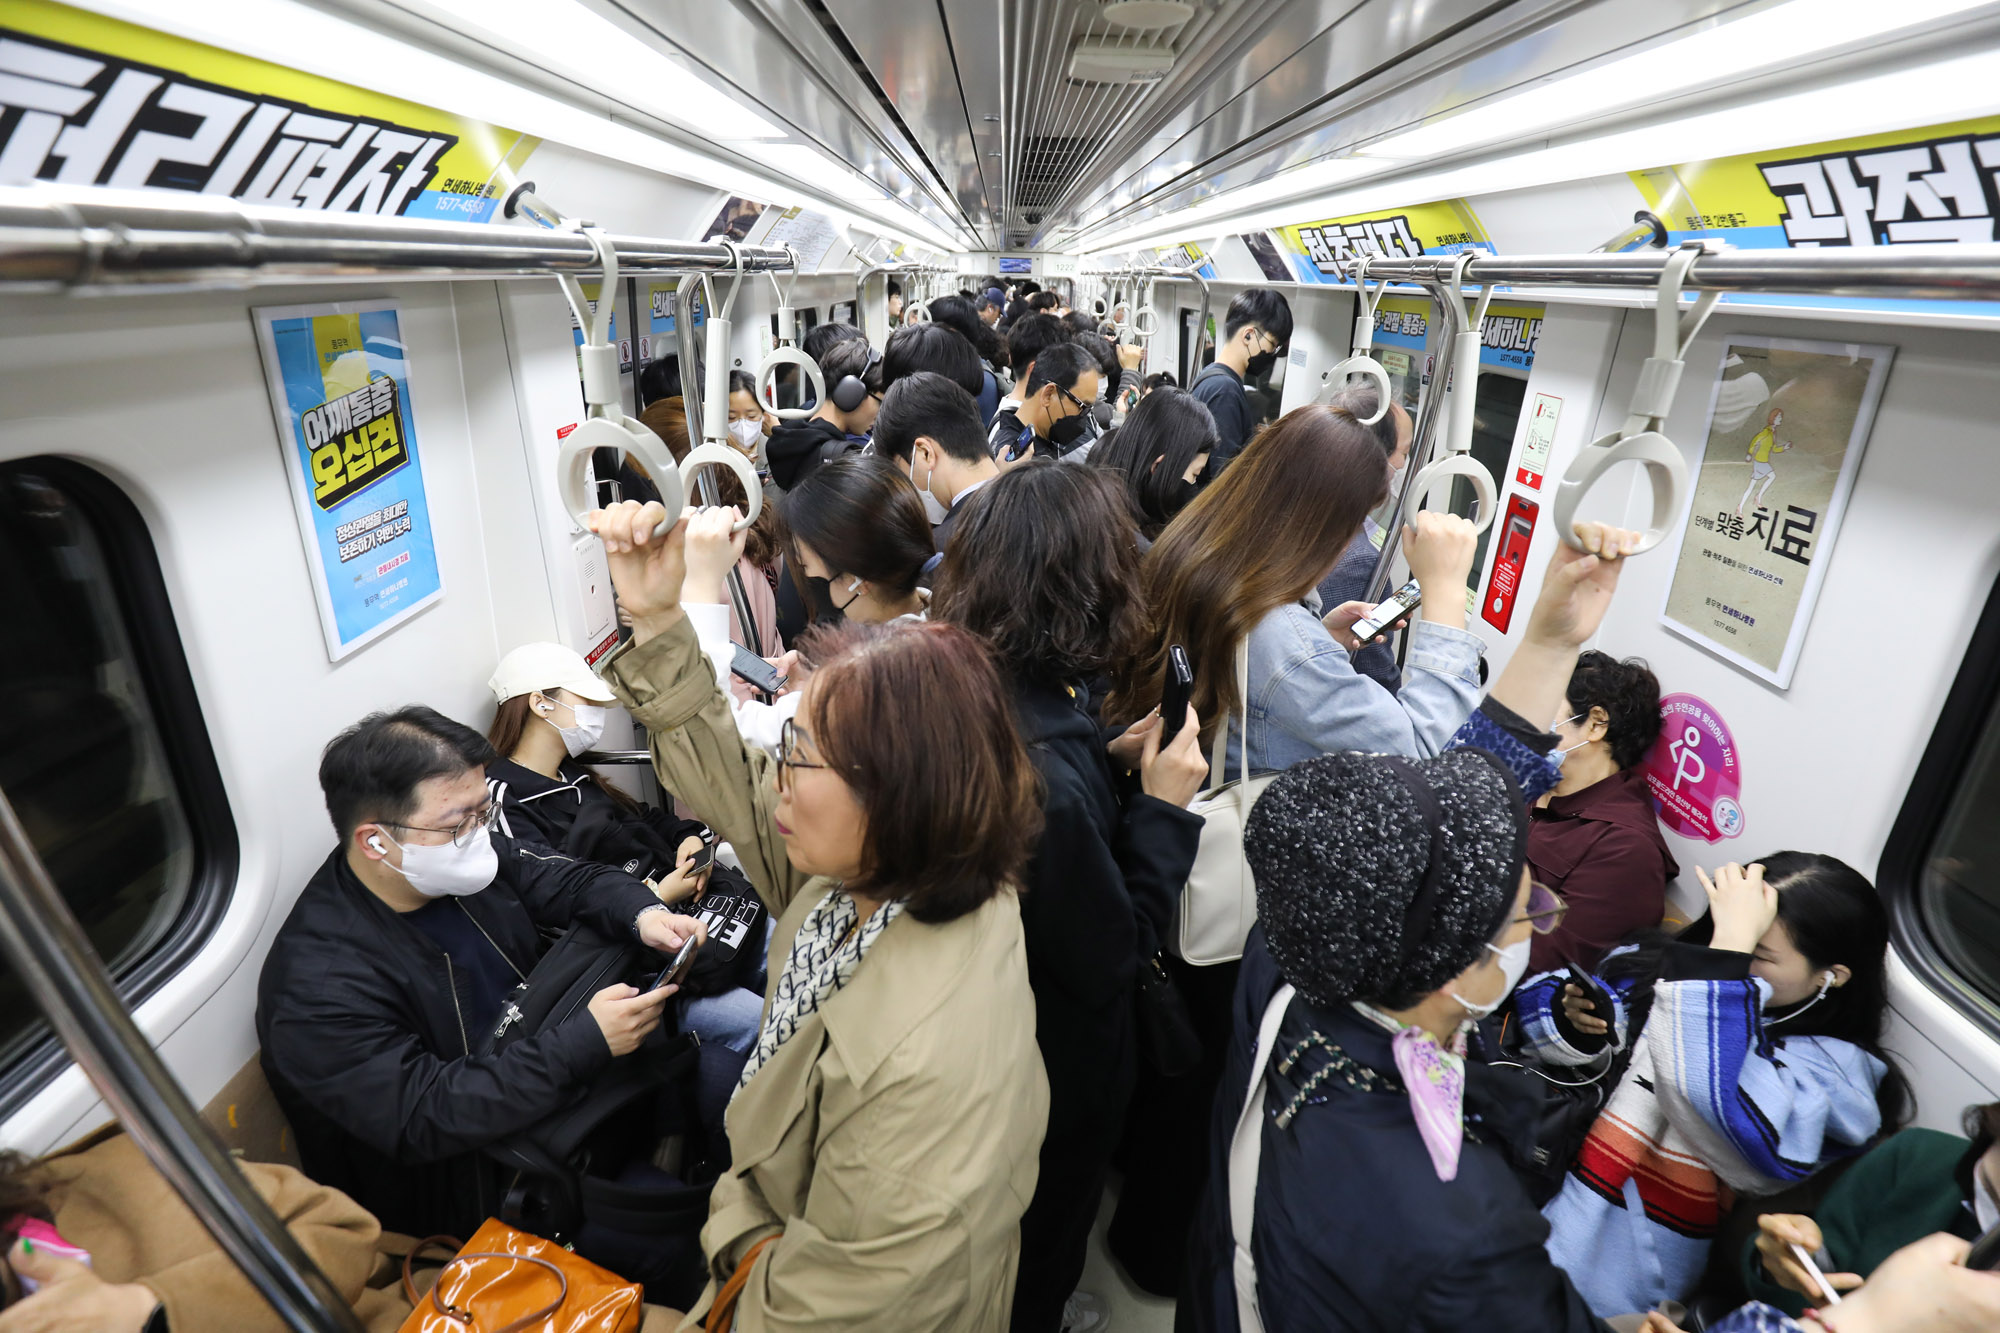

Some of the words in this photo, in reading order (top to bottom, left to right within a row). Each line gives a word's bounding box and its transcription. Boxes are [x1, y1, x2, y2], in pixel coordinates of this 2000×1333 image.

[436, 196, 485, 213] 1577-4558
[1758, 138, 2000, 247] 관절
[1374, 309, 1426, 337] 추·관절·통증은
[302, 378, 393, 450] 어깨통증
[312, 411, 400, 501] 오십견
[336, 509, 382, 544] 정상관절을
[383, 499, 408, 523] 최대한
[339, 532, 376, 562] 보존하기
[376, 523, 394, 546] 위한
[394, 515, 411, 537] 노력
[1695, 515, 1714, 531] 단계별
[1716, 511, 1744, 541] 맞춤
[1746, 504, 1817, 566] 치료
[1660, 703, 1674, 718] 일의
[1675, 702, 1702, 718] 주인공을
[1722, 747, 1734, 767] 자리
[1659, 792, 1667, 802] the
[1667, 800, 1690, 820] pregnant
[1675, 794, 1691, 810] 임산부
[1691, 806, 1708, 824] 배려석
